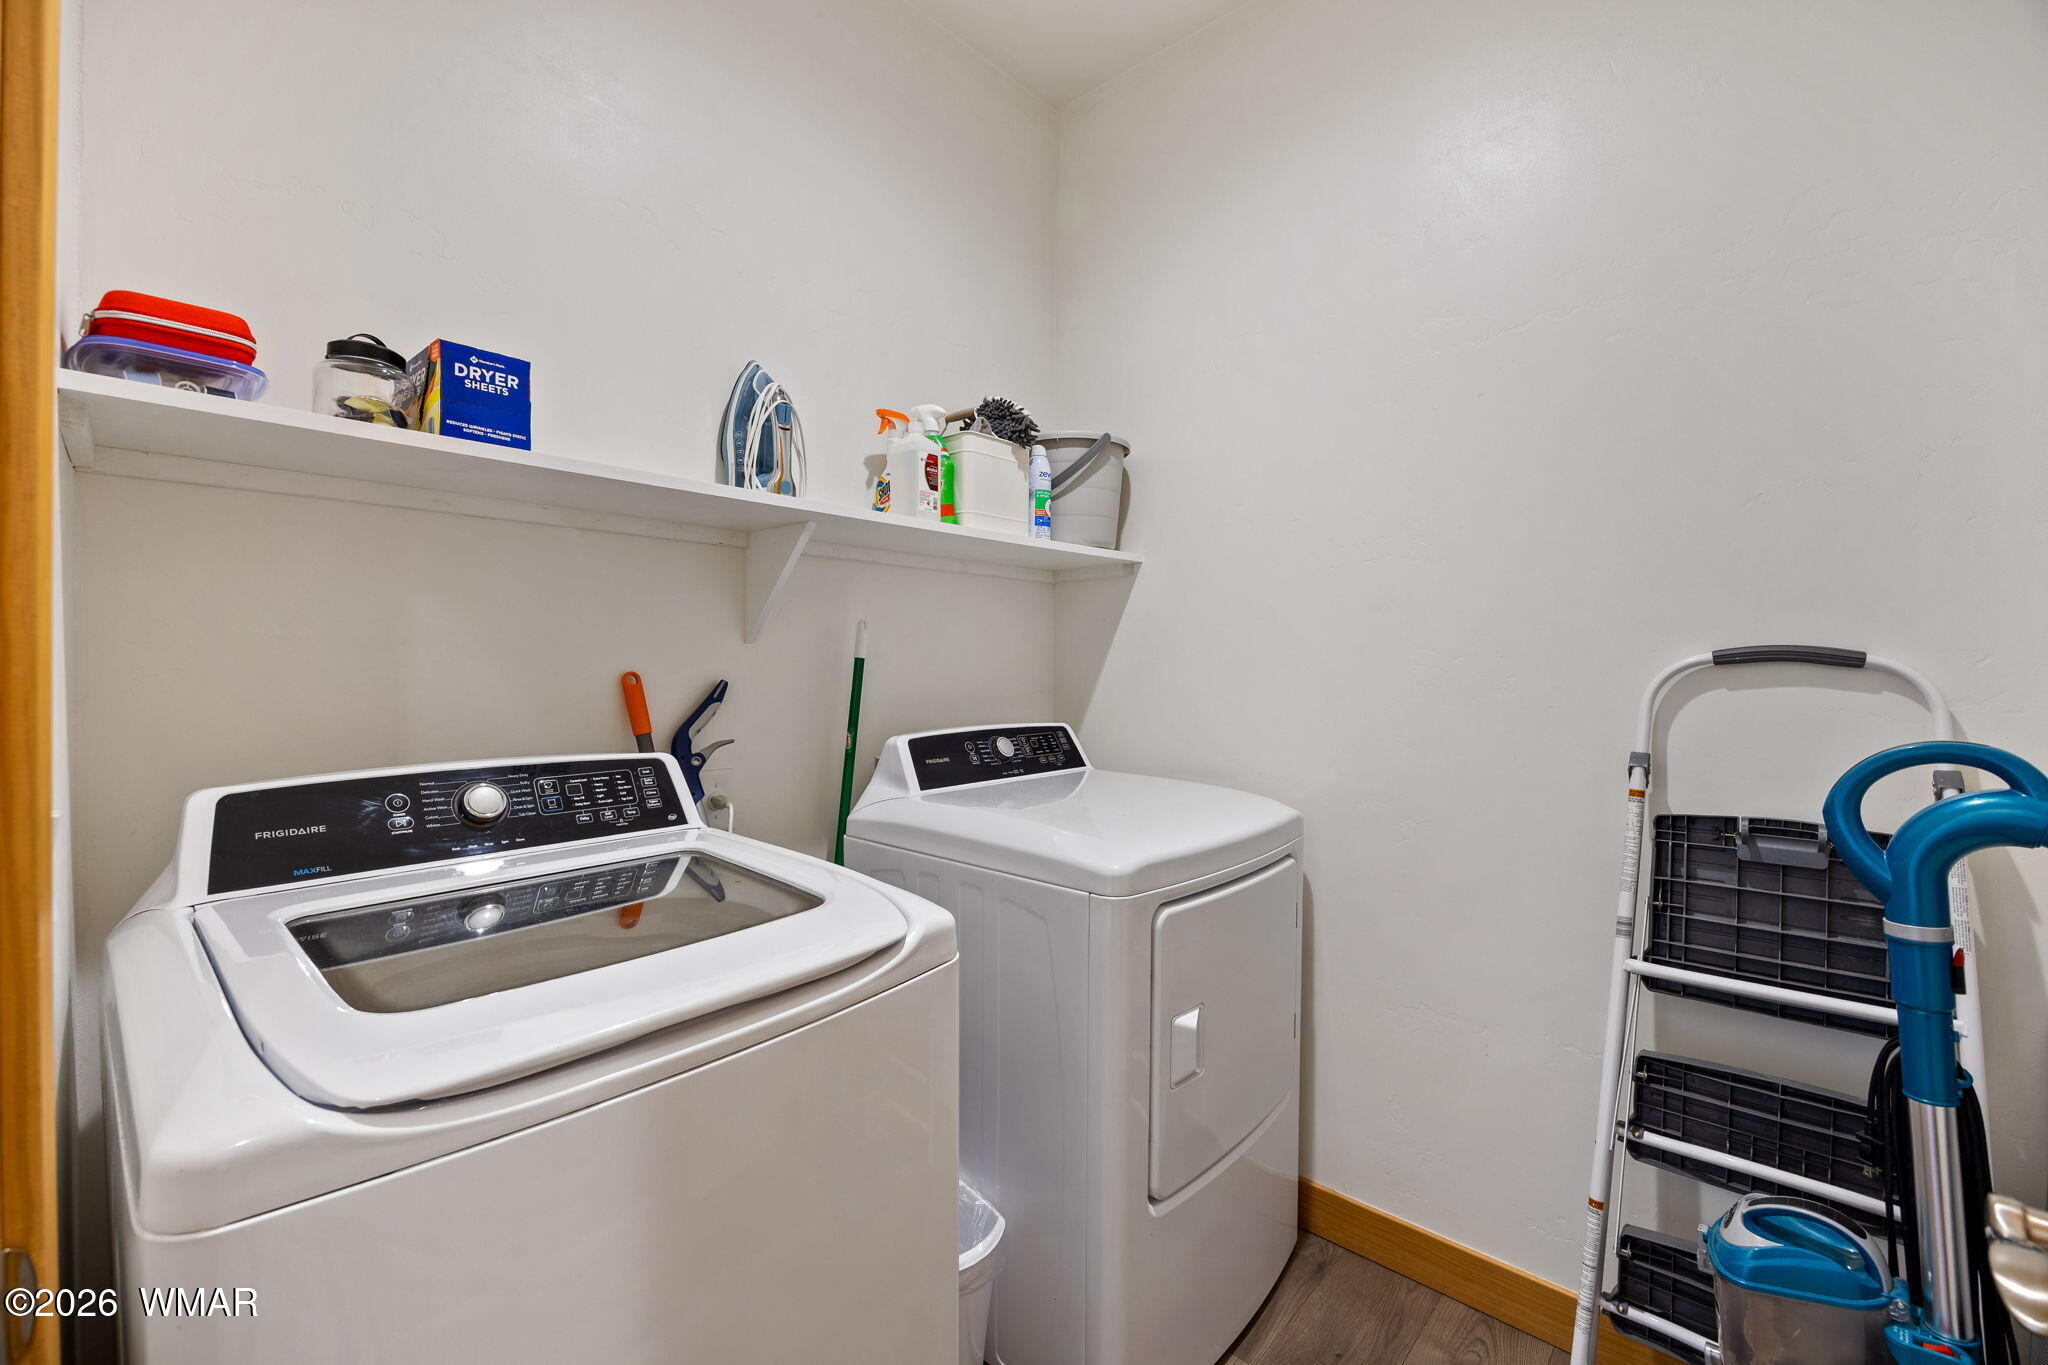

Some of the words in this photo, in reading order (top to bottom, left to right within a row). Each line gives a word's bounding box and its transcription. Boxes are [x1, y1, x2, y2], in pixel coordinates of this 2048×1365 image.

[454, 362, 519, 390] DRYER
[464, 379, 509, 396] SHEETS
[446, 419, 468, 428] REDUCES
[468, 424, 493, 433] WRINKLES
[463, 427, 484, 436] SOFTENS
[487, 432, 511, 442] FRESHENS
[254, 825, 327, 840] FRIGIDAIRE
[293, 865, 332, 877] MAXFILL
